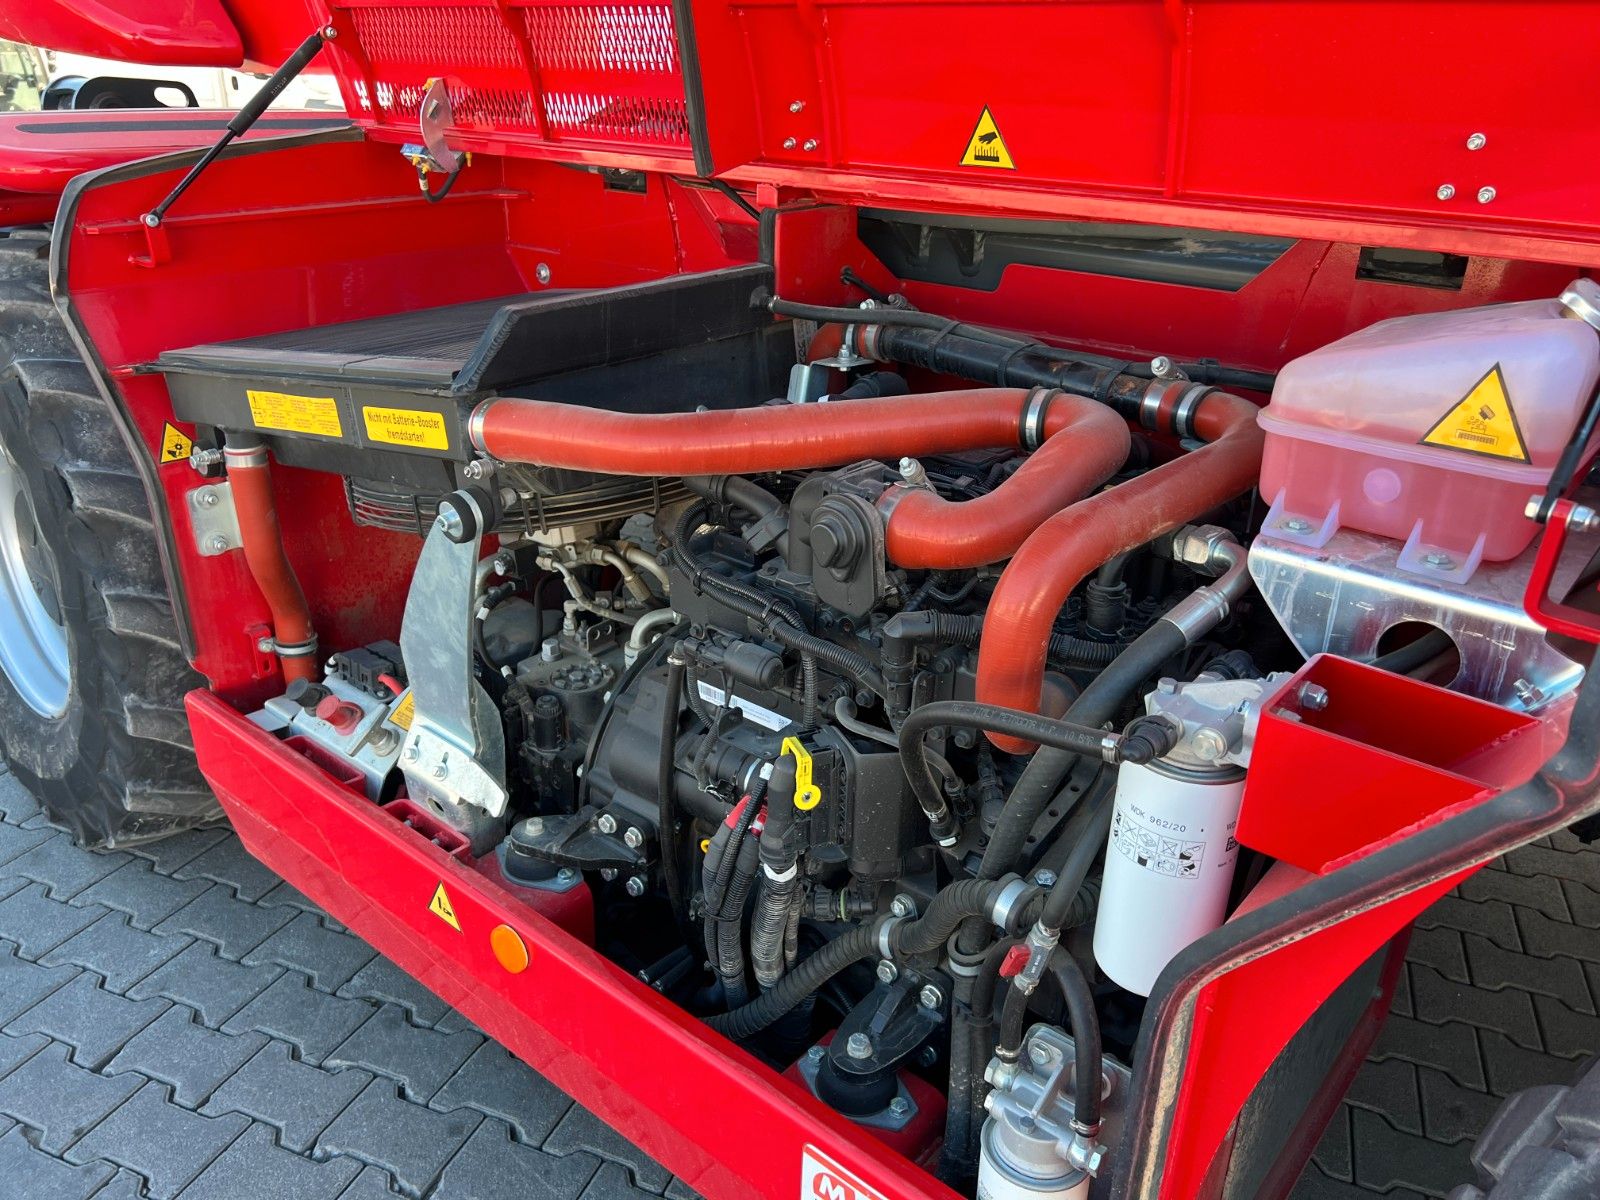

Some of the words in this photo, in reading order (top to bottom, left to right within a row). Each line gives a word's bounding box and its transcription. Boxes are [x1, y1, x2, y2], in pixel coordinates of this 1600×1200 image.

[368, 412, 382, 423] Nicht
[383, 415, 392, 424] mit
[1130, 803, 1146, 818] WDK
[1149, 816, 1186, 832] 962/20
[1226, 821, 1237, 830] WD
